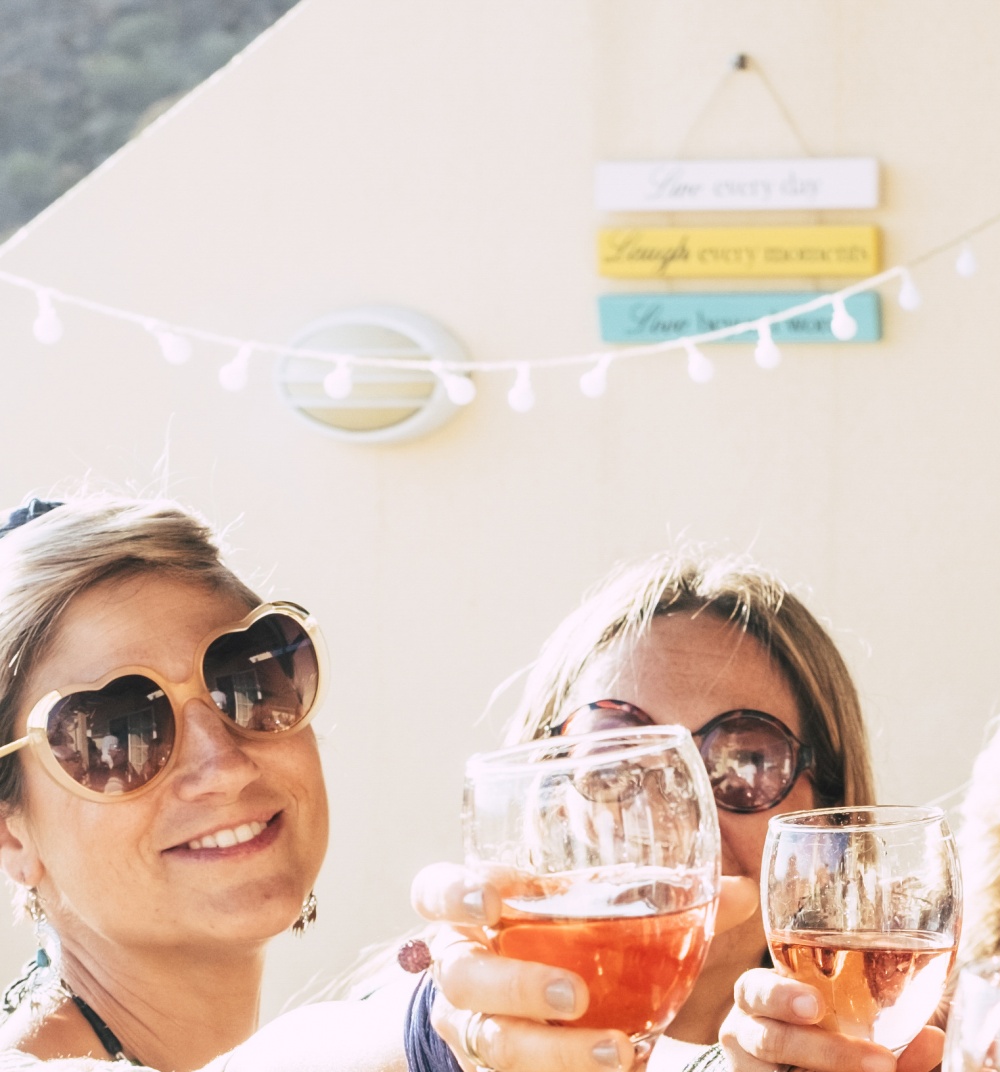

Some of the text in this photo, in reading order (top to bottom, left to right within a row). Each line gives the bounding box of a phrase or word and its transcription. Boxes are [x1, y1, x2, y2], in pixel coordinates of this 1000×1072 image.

[712, 179, 773, 201] every
[778, 169, 822, 201] day
[604, 229, 869, 276] Laugh every moments
[625, 303, 690, 336] Love
